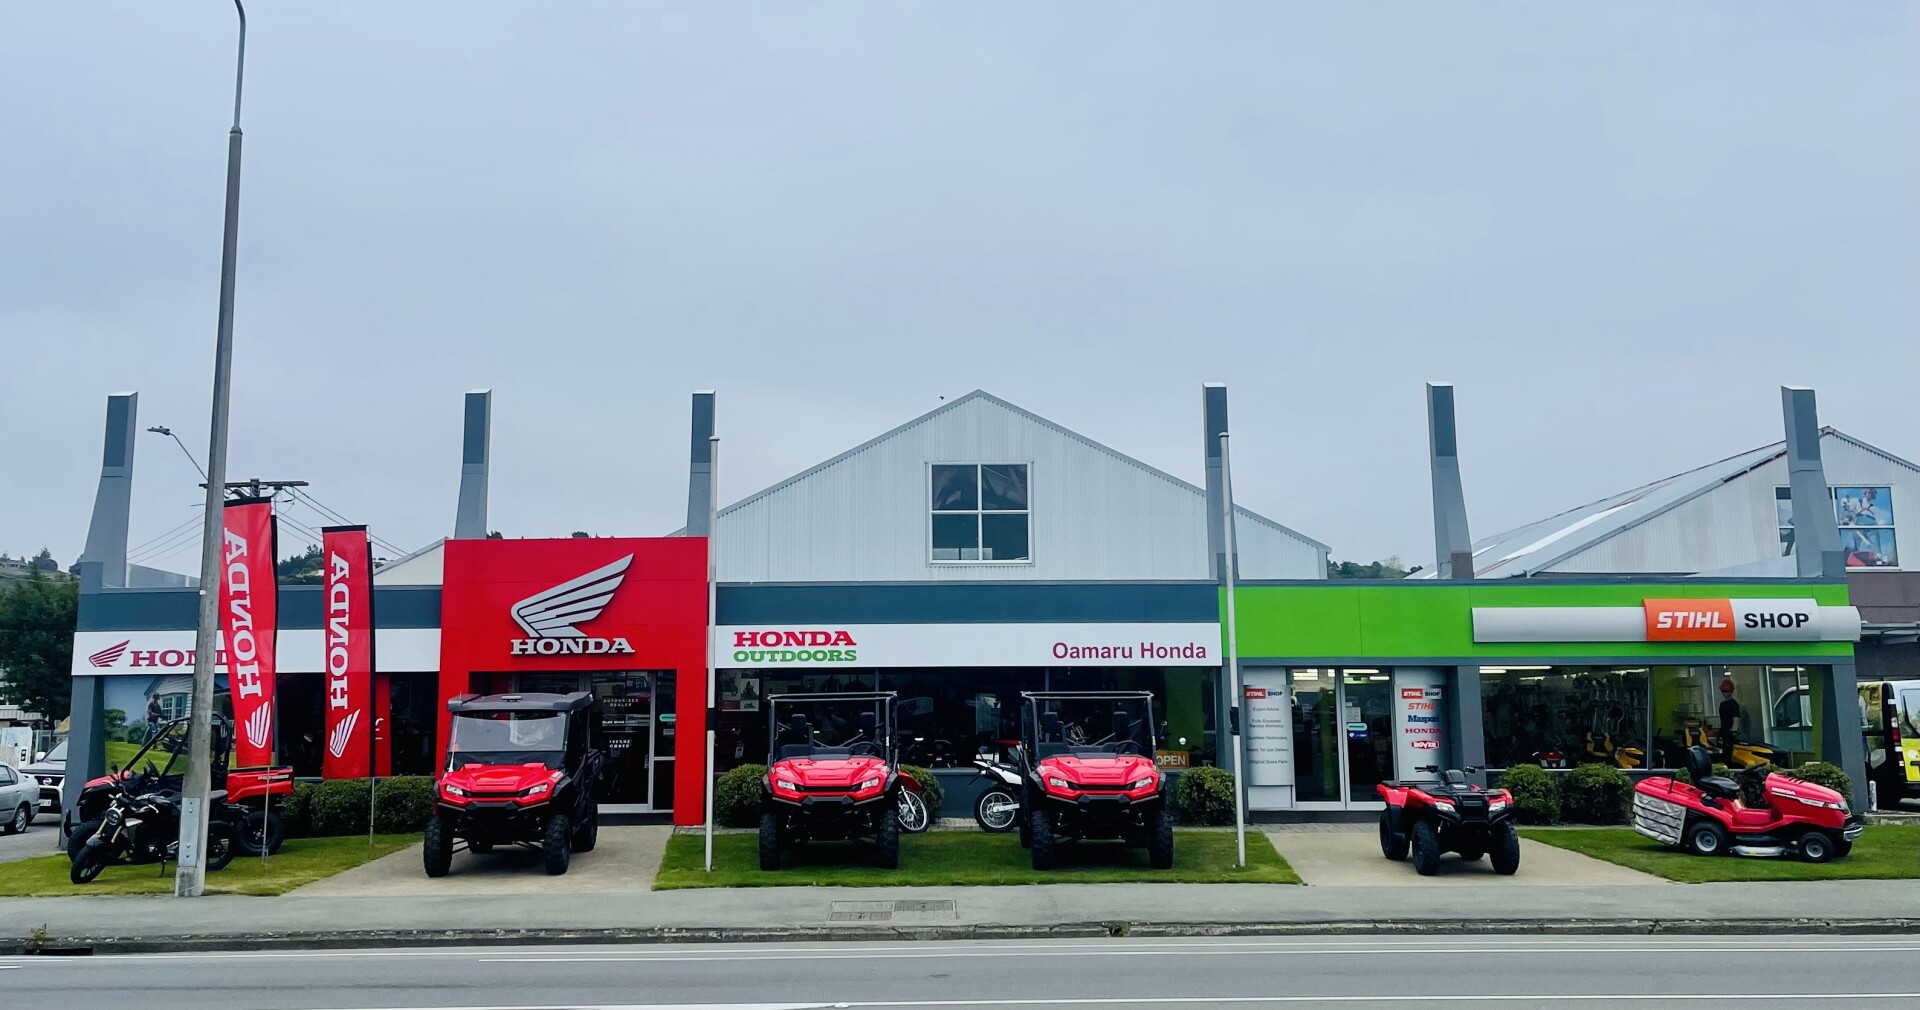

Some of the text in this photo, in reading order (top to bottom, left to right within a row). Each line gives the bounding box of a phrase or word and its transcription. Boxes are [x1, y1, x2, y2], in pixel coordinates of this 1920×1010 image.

[1656, 611, 1809, 629] STIHL SHOP
[510, 637, 636, 655] HONDA
[733, 631, 857, 647] HONDA
[733, 649, 857, 663] OUTDOORS
[1052, 642, 1207, 659] Oamaru Honda
[1413, 741, 1437, 749] ROVER
[1156, 755, 1186, 766] OPEN
